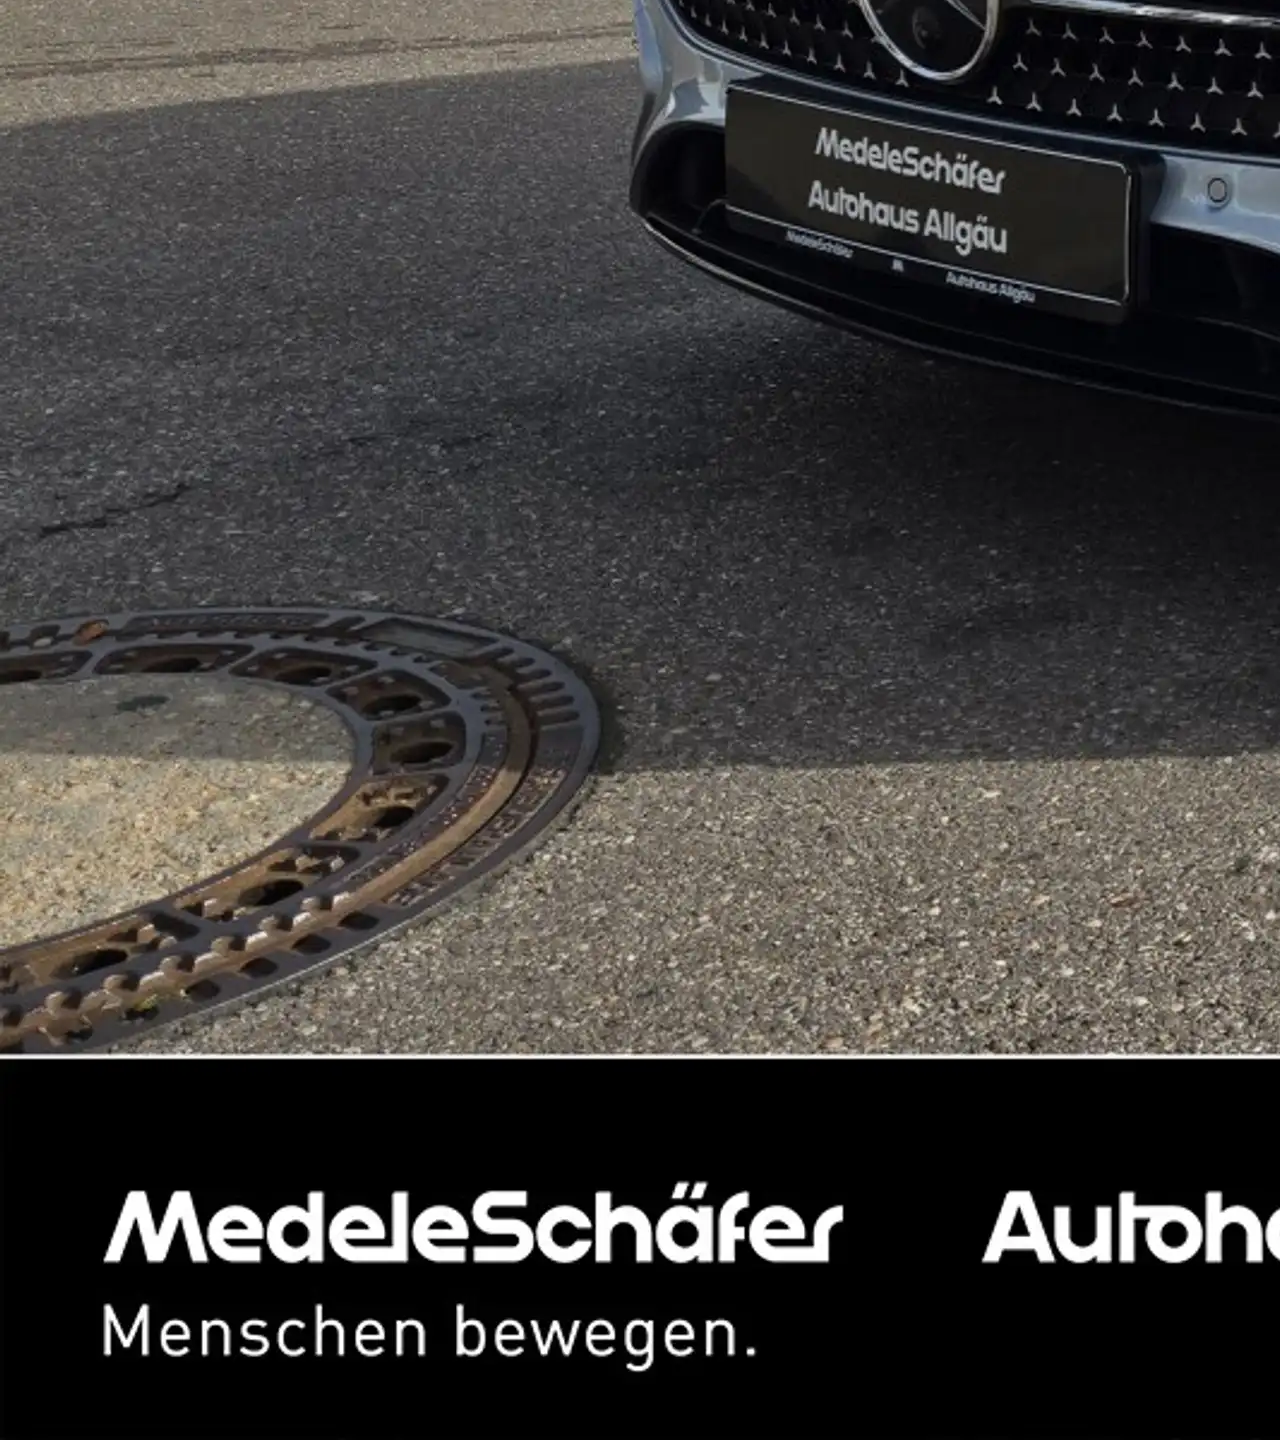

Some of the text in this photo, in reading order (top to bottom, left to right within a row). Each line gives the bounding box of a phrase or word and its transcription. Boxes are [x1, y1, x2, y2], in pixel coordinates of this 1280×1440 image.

[814, 126, 1006, 195] MedeleSchäfer
[808, 179, 1008, 256] Autohaus Allgäu
